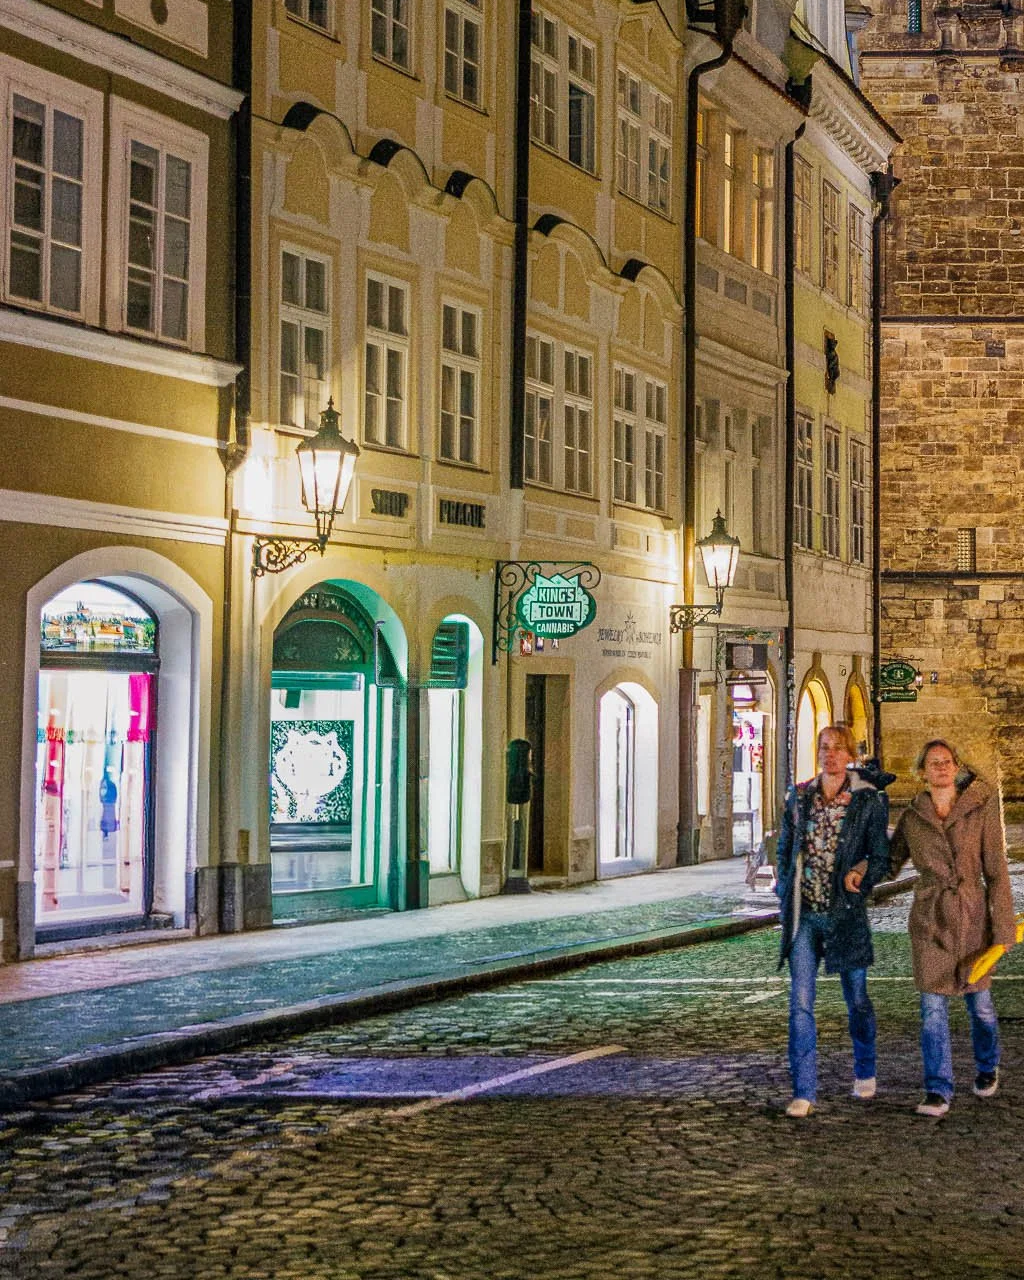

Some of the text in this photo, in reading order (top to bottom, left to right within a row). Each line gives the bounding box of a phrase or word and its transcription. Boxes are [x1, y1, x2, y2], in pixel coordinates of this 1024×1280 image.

[371, 488, 486, 528] SHOP PRAGUE
[538, 588, 576, 602] KING'S
[538, 605, 574, 618] TOWN
[536, 622, 575, 633] CANNABIS
